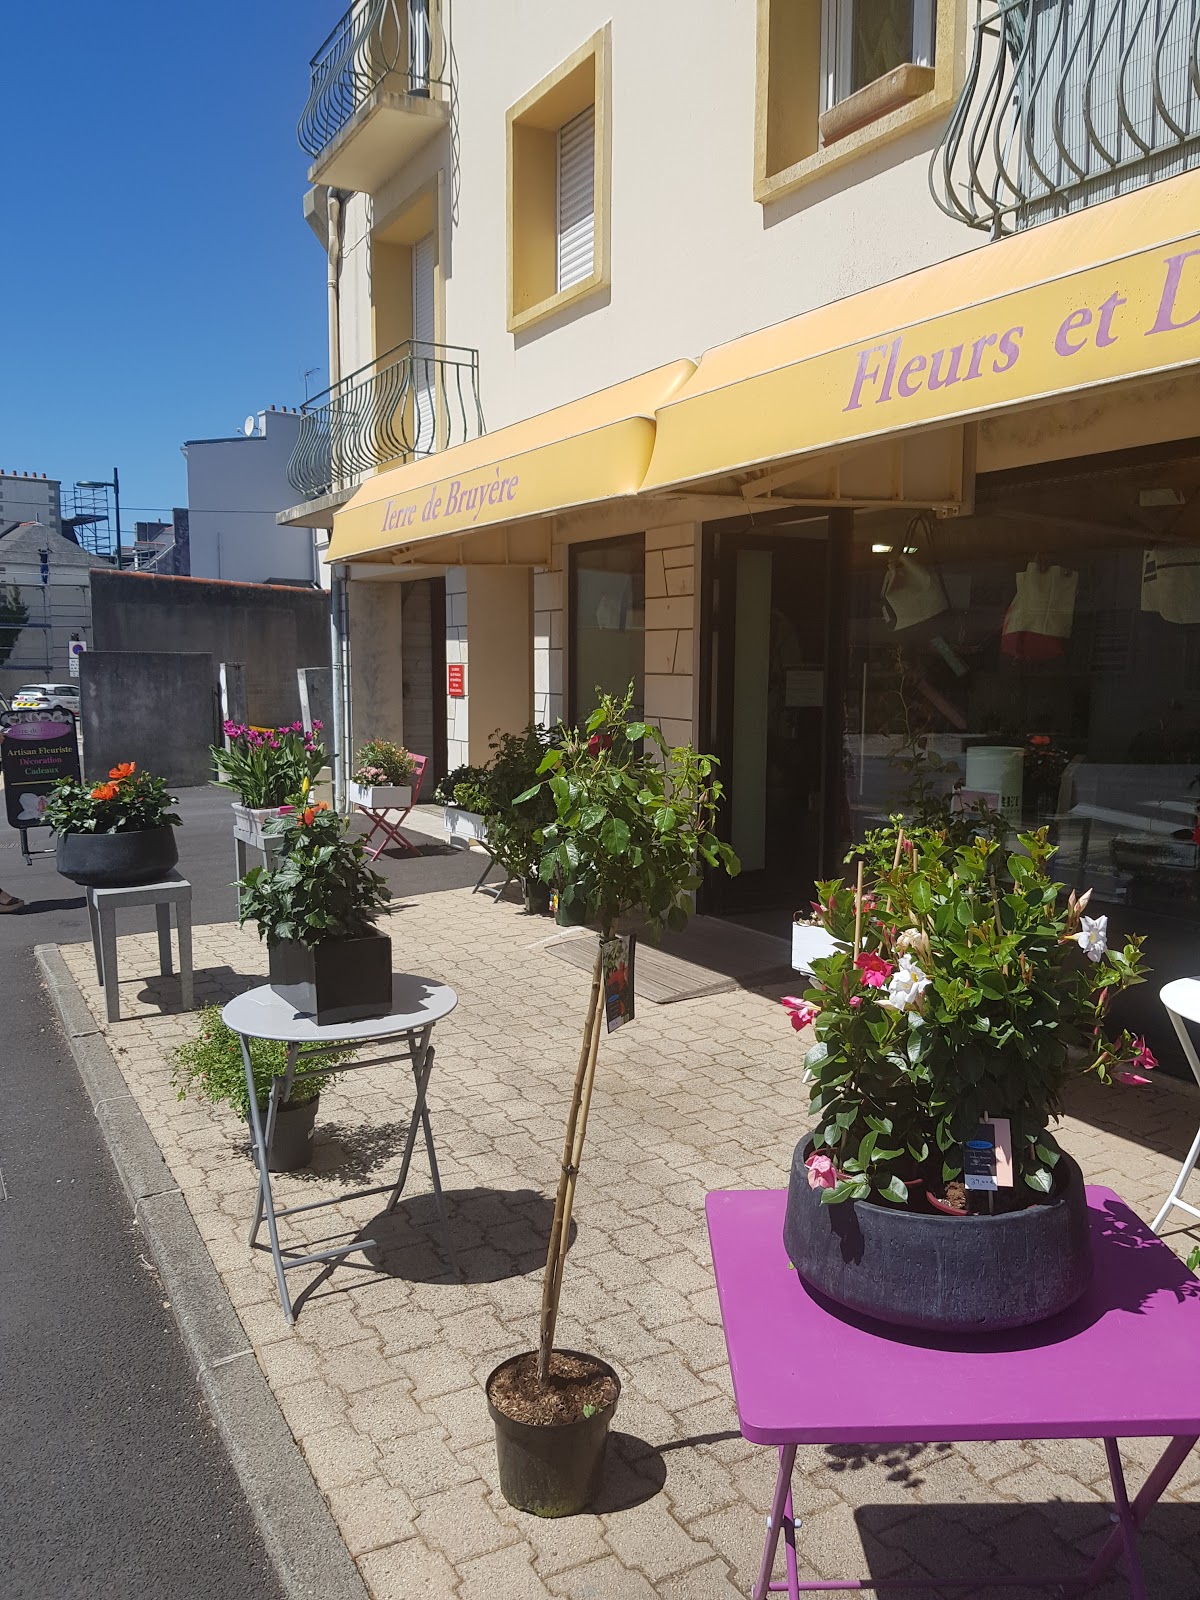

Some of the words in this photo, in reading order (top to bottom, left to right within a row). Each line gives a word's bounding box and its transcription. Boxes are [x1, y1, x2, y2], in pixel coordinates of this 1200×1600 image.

[842, 325, 1024, 412] Fleurs
[1054, 291, 1127, 356] et
[380, 498, 417, 532] Terre
[421, 485, 443, 523] de
[443, 466, 519, 522] Bruyère
[38, 746, 73, 754] Fleuriste
[20, 757, 62, 765] Décoration
[24, 767, 60, 775] Cadeaux
